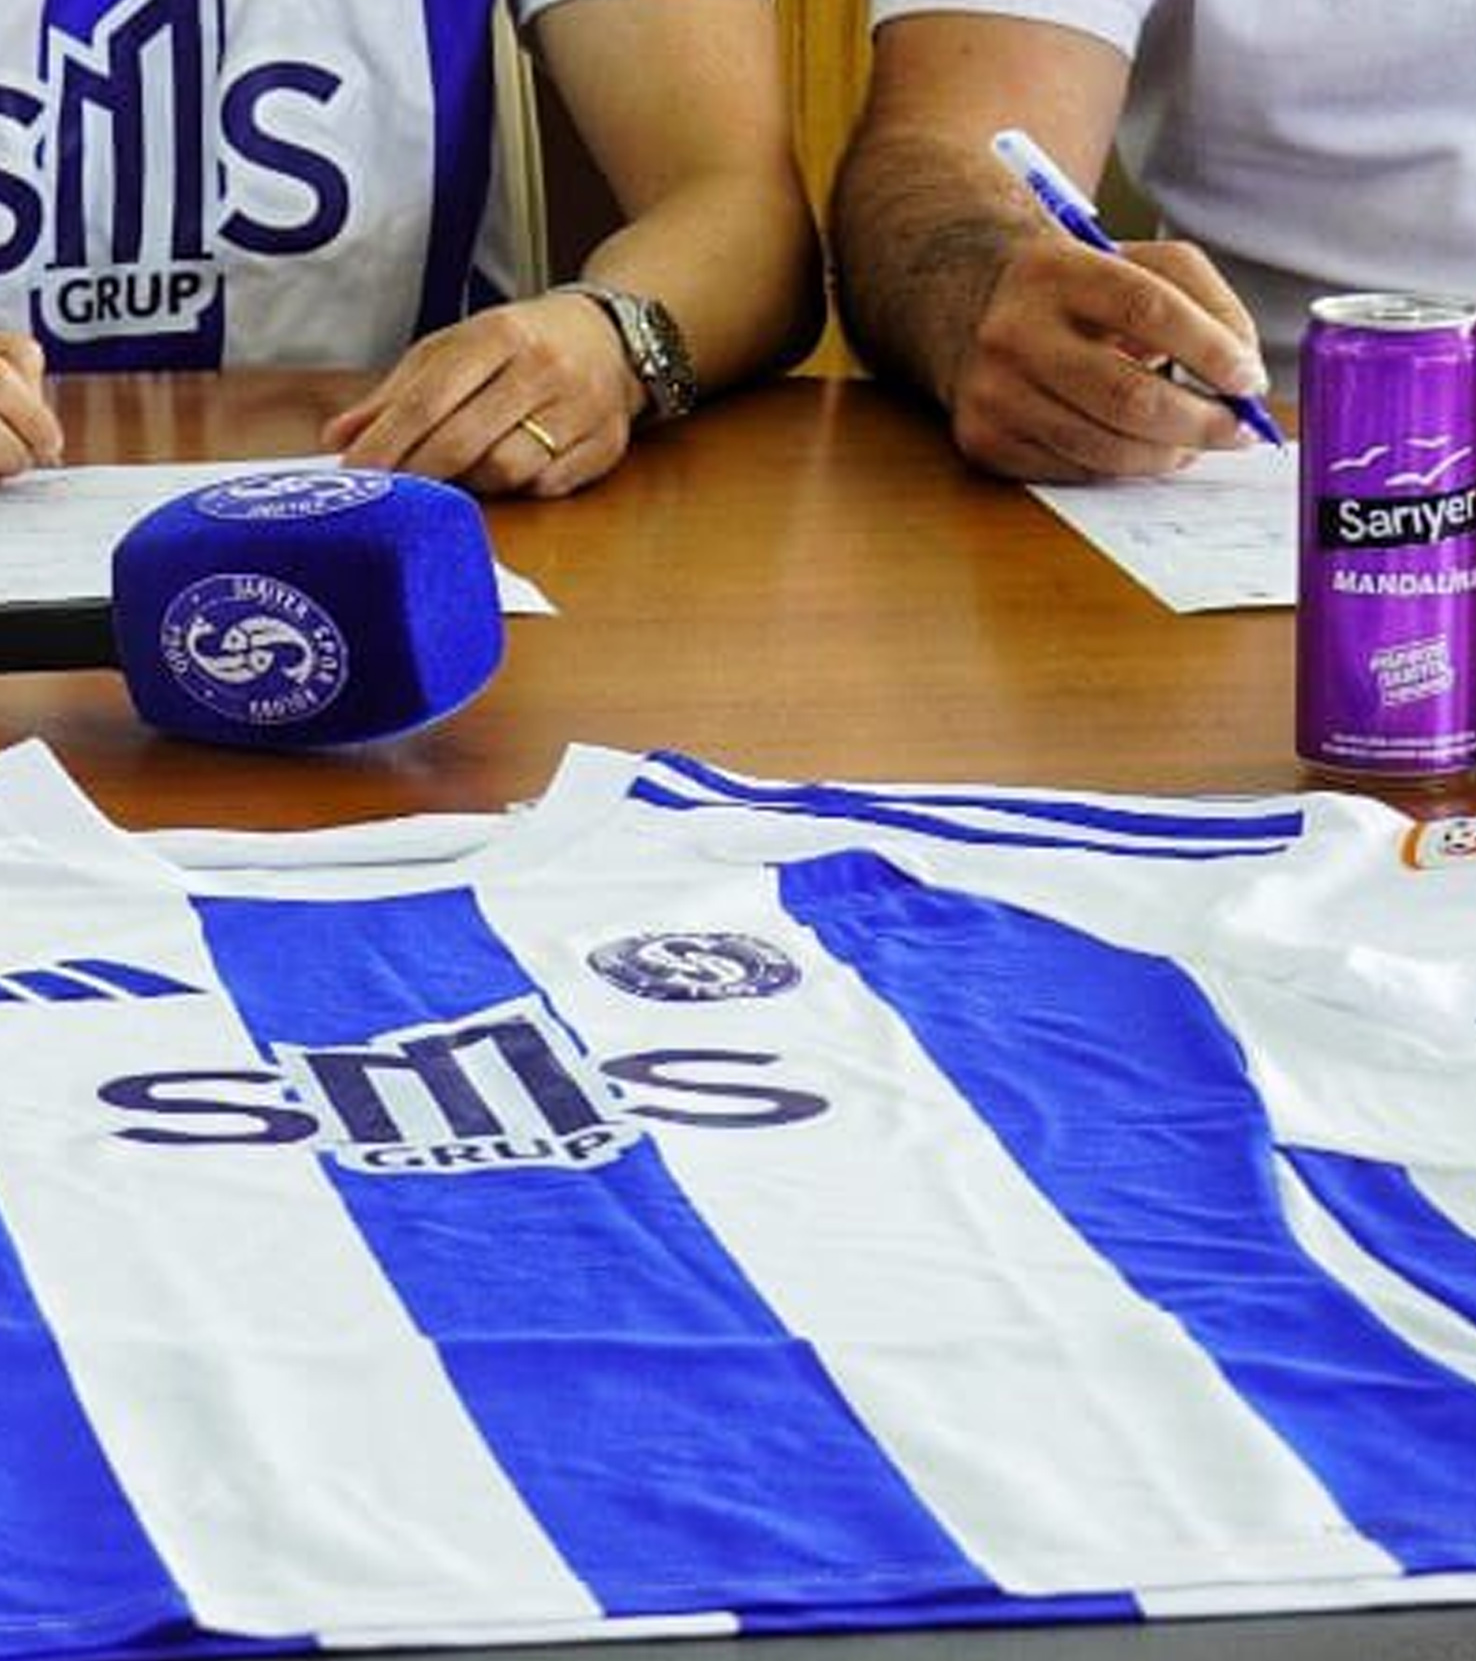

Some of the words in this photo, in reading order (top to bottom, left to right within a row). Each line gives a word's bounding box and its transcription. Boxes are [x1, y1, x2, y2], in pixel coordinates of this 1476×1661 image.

[57, 271, 201, 325] GRUP
[96, 1015, 830, 1146] SMS
[362, 1130, 615, 1169] GRUP
